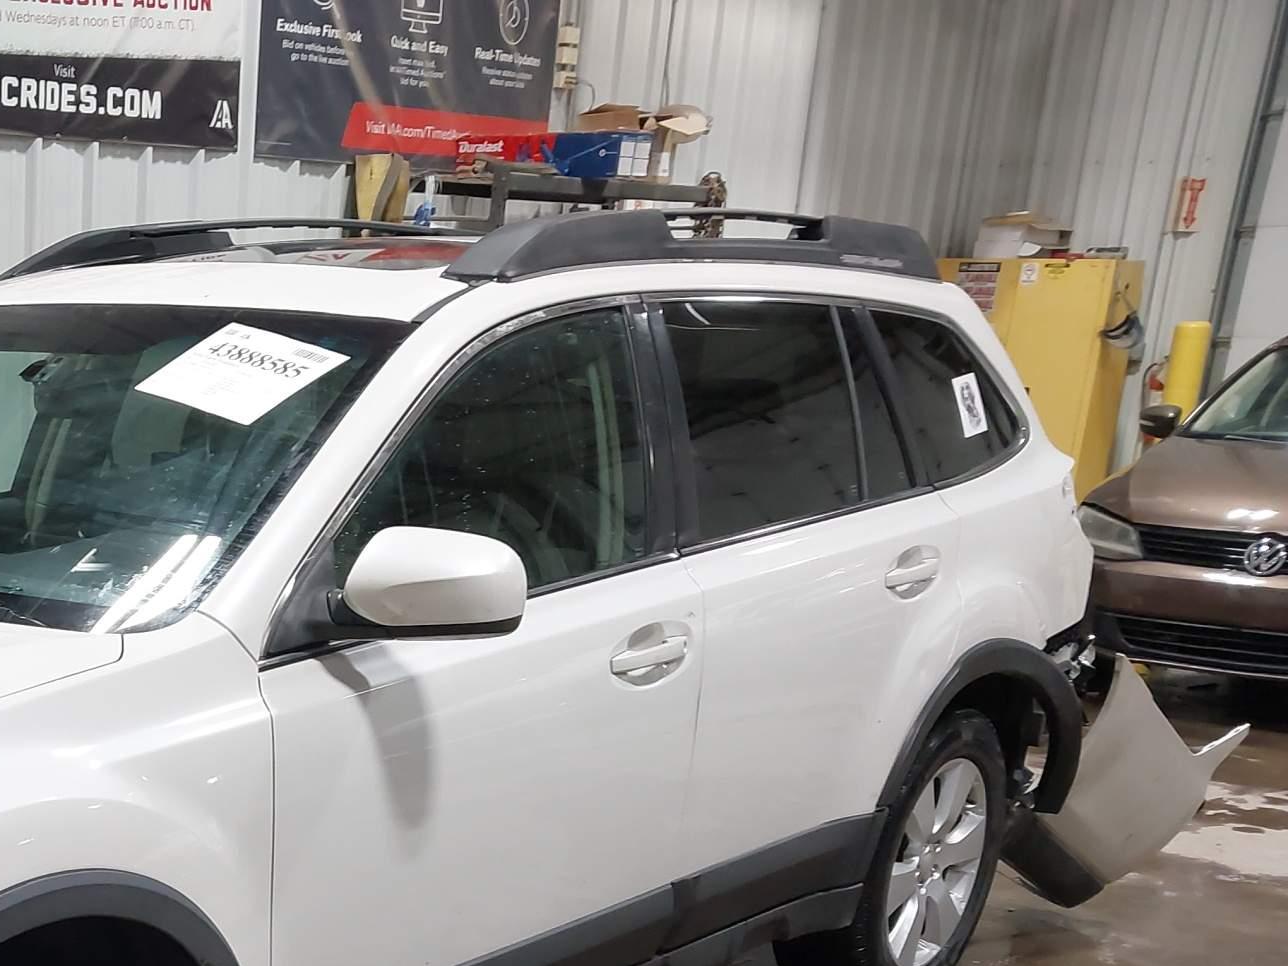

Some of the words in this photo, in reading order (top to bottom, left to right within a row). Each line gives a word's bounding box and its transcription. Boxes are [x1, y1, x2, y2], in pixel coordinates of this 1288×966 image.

[6, 11, 67, 27] Wednesdays
[69, 16, 79, 26] at
[83, 17, 109, 27] noon
[112, 16, 125, 28] ET
[276, 18, 321, 37] Exclusive
[345, 30, 363, 43] ook
[391, 35, 410, 50] Quick
[411, 41, 427, 52] and
[428, 41, 449, 56] Easy
[475, 47, 513, 63] Real-Time
[514, 51, 541, 68] Updates
[53, 64, 76, 78] Visit
[366, 120, 386, 134] Visit
[458, 140, 504, 153] Duralast
[208, 342, 311, 379] 43888585
